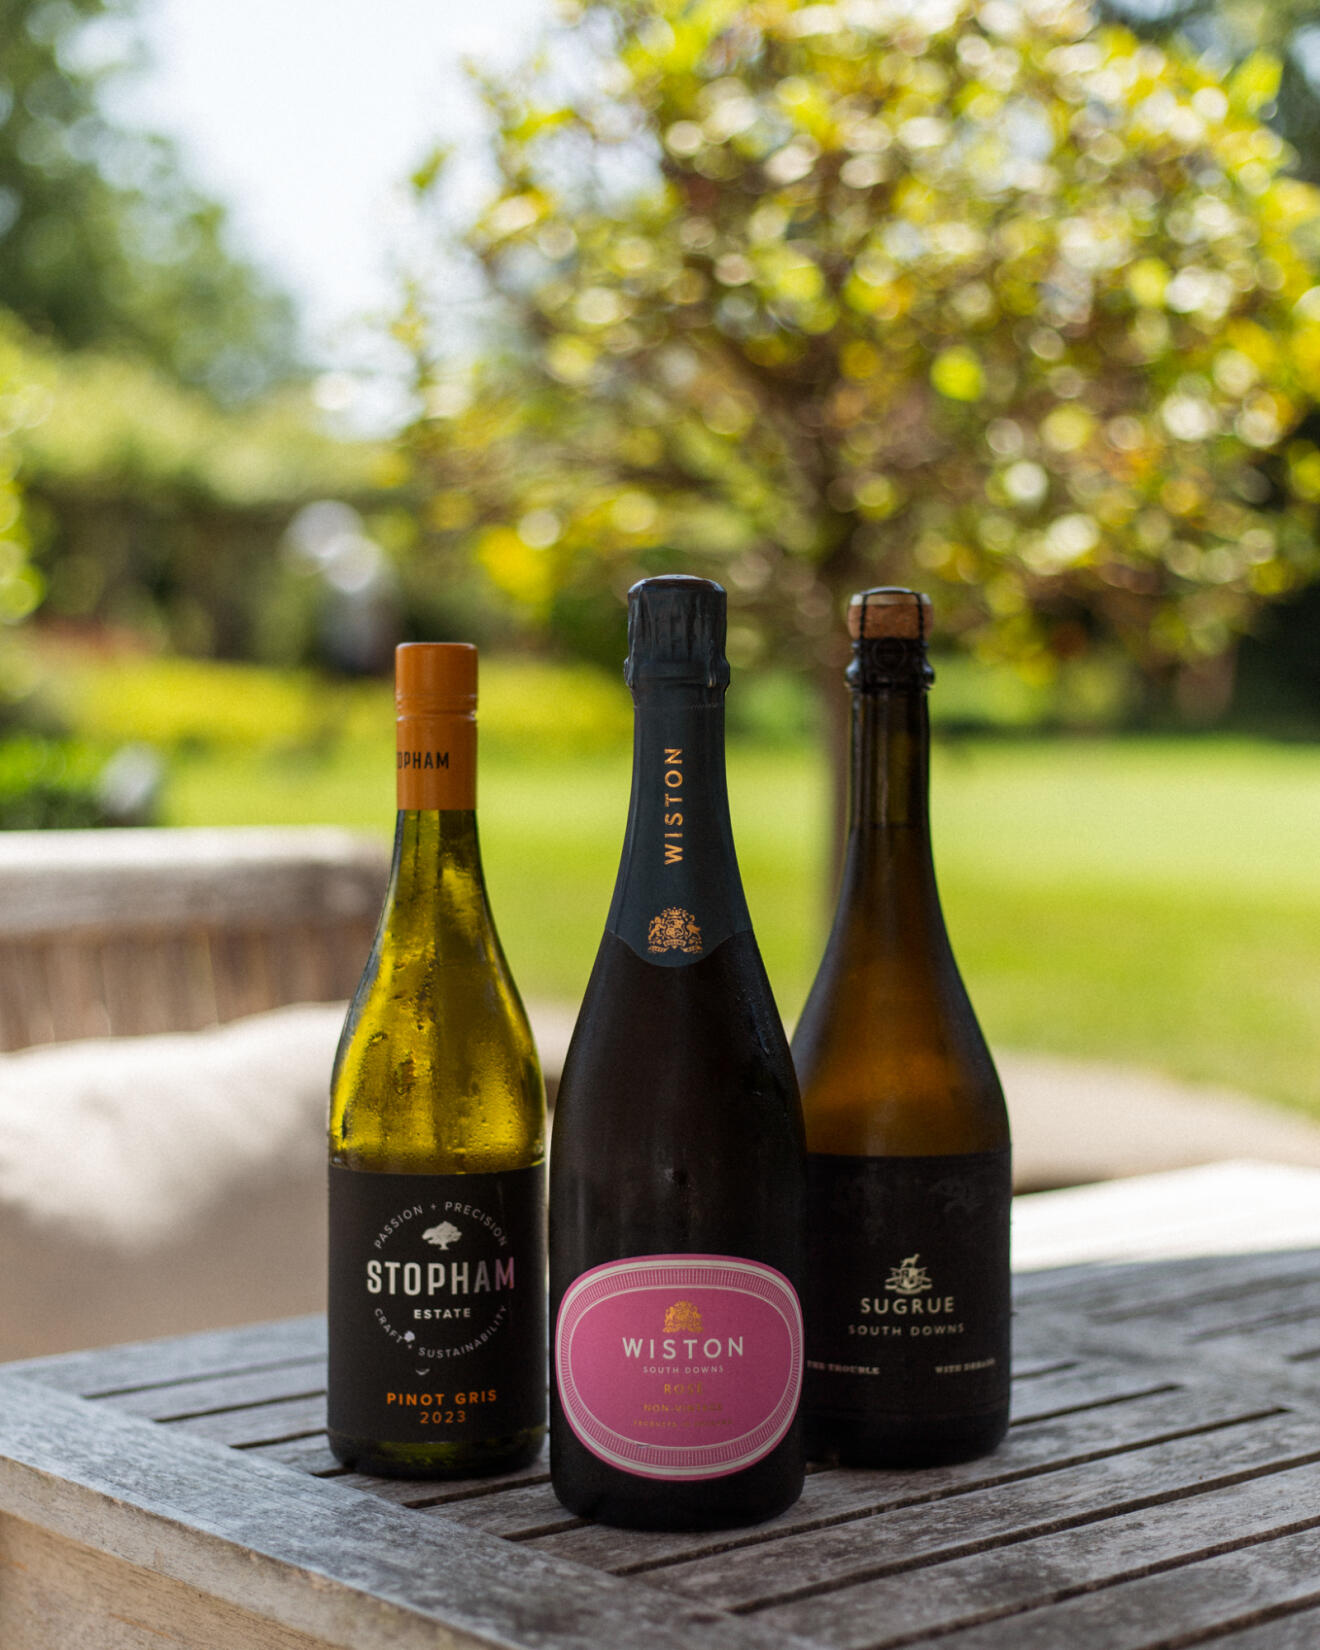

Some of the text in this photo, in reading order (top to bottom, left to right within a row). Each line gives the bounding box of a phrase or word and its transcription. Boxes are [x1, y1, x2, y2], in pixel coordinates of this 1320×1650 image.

[664, 748, 683, 865] WISTON
[374, 1204, 424, 1249] PASSION
[444, 1201, 507, 1247] PRECISION
[366, 1256, 515, 1296] STOPHAM
[413, 1308, 471, 1320] ESTATE
[860, 1296, 955, 1315] SUGRUE
[374, 1308, 405, 1343] CRAFT
[418, 1305, 507, 1359] SUSTAINABILITY
[848, 1322, 965, 1336] SOUTH DOWNS
[622, 1336, 744, 1360] WISTON
[642, 1364, 724, 1374] SOUTH DOWNS
[386, 1389, 498, 1406] PINOT GRIS
[419, 1410, 467, 1424] 2023
